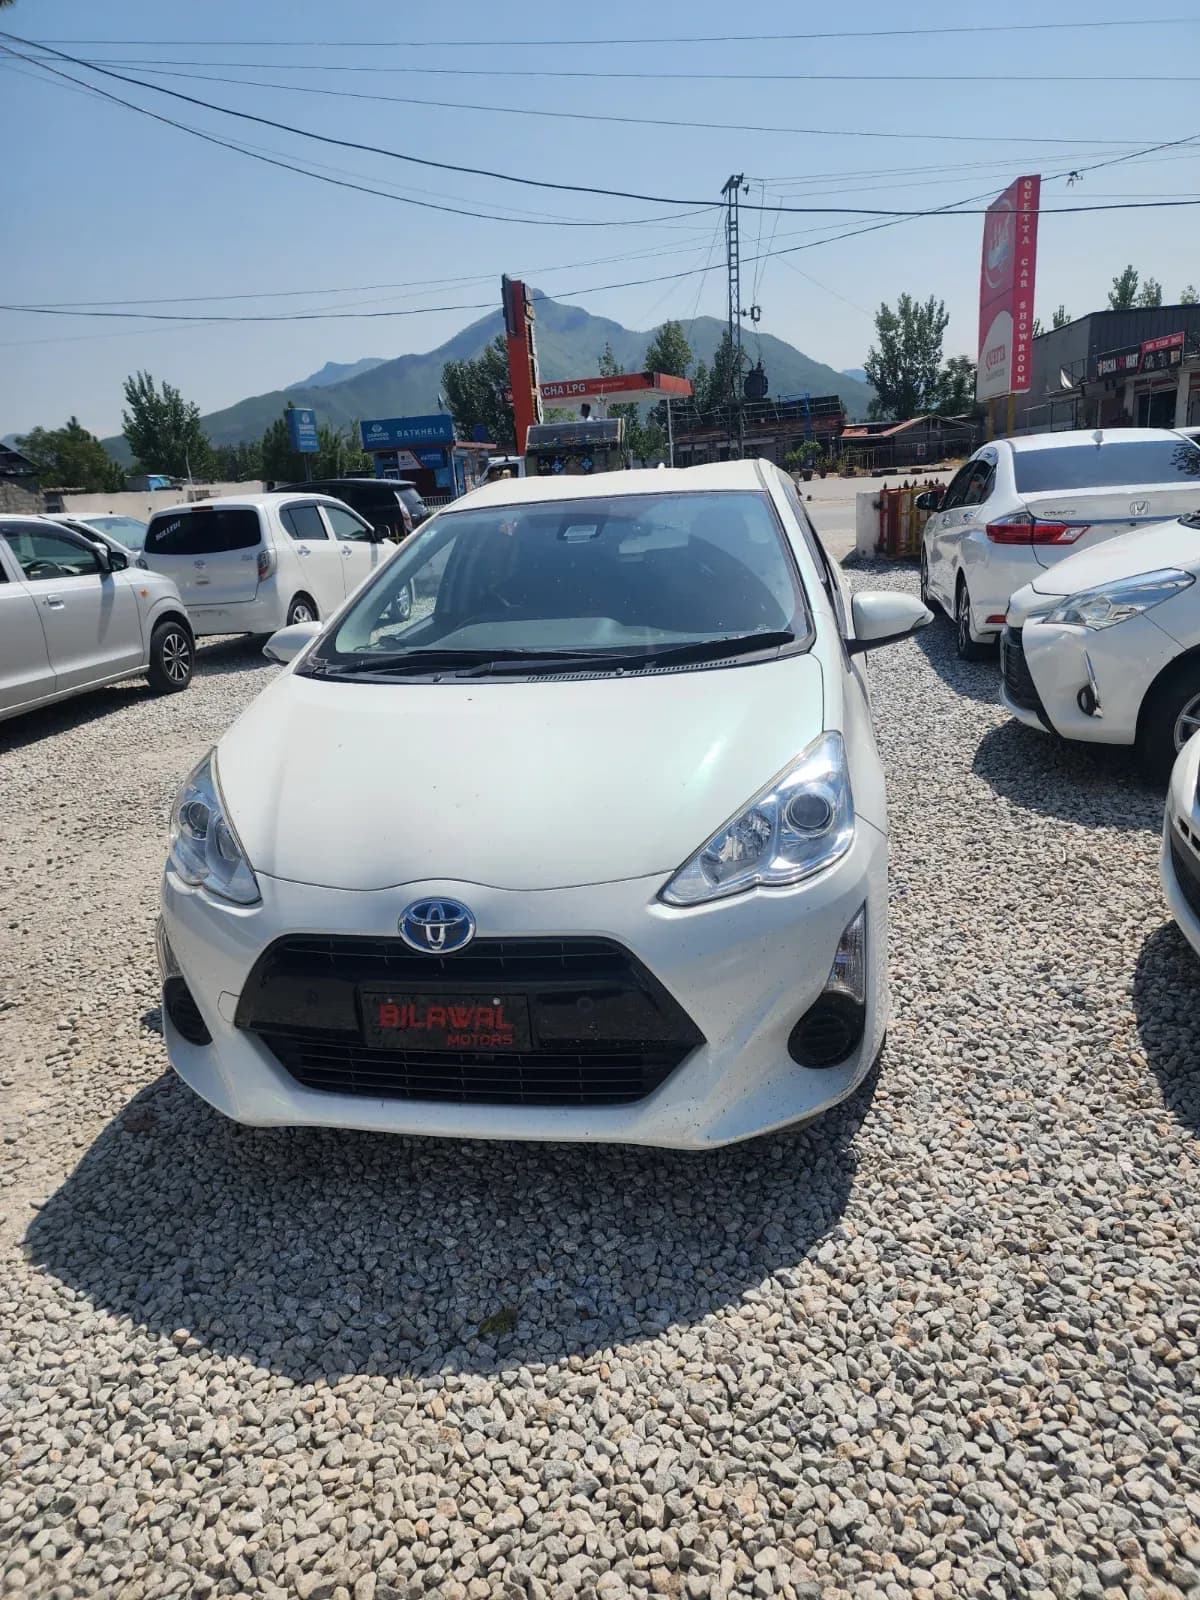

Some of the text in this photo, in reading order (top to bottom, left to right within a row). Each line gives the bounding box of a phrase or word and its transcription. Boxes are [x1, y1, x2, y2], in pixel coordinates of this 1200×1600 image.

[1017, 180, 1032, 383] QUETTA CAR SHOWROOM
[566, 383, 586, 395] LPG
[396, 427, 446, 438] BATKHELA
[379, 1003, 514, 1031] BILAWAL
[447, 1034, 513, 1047] MOTORS
